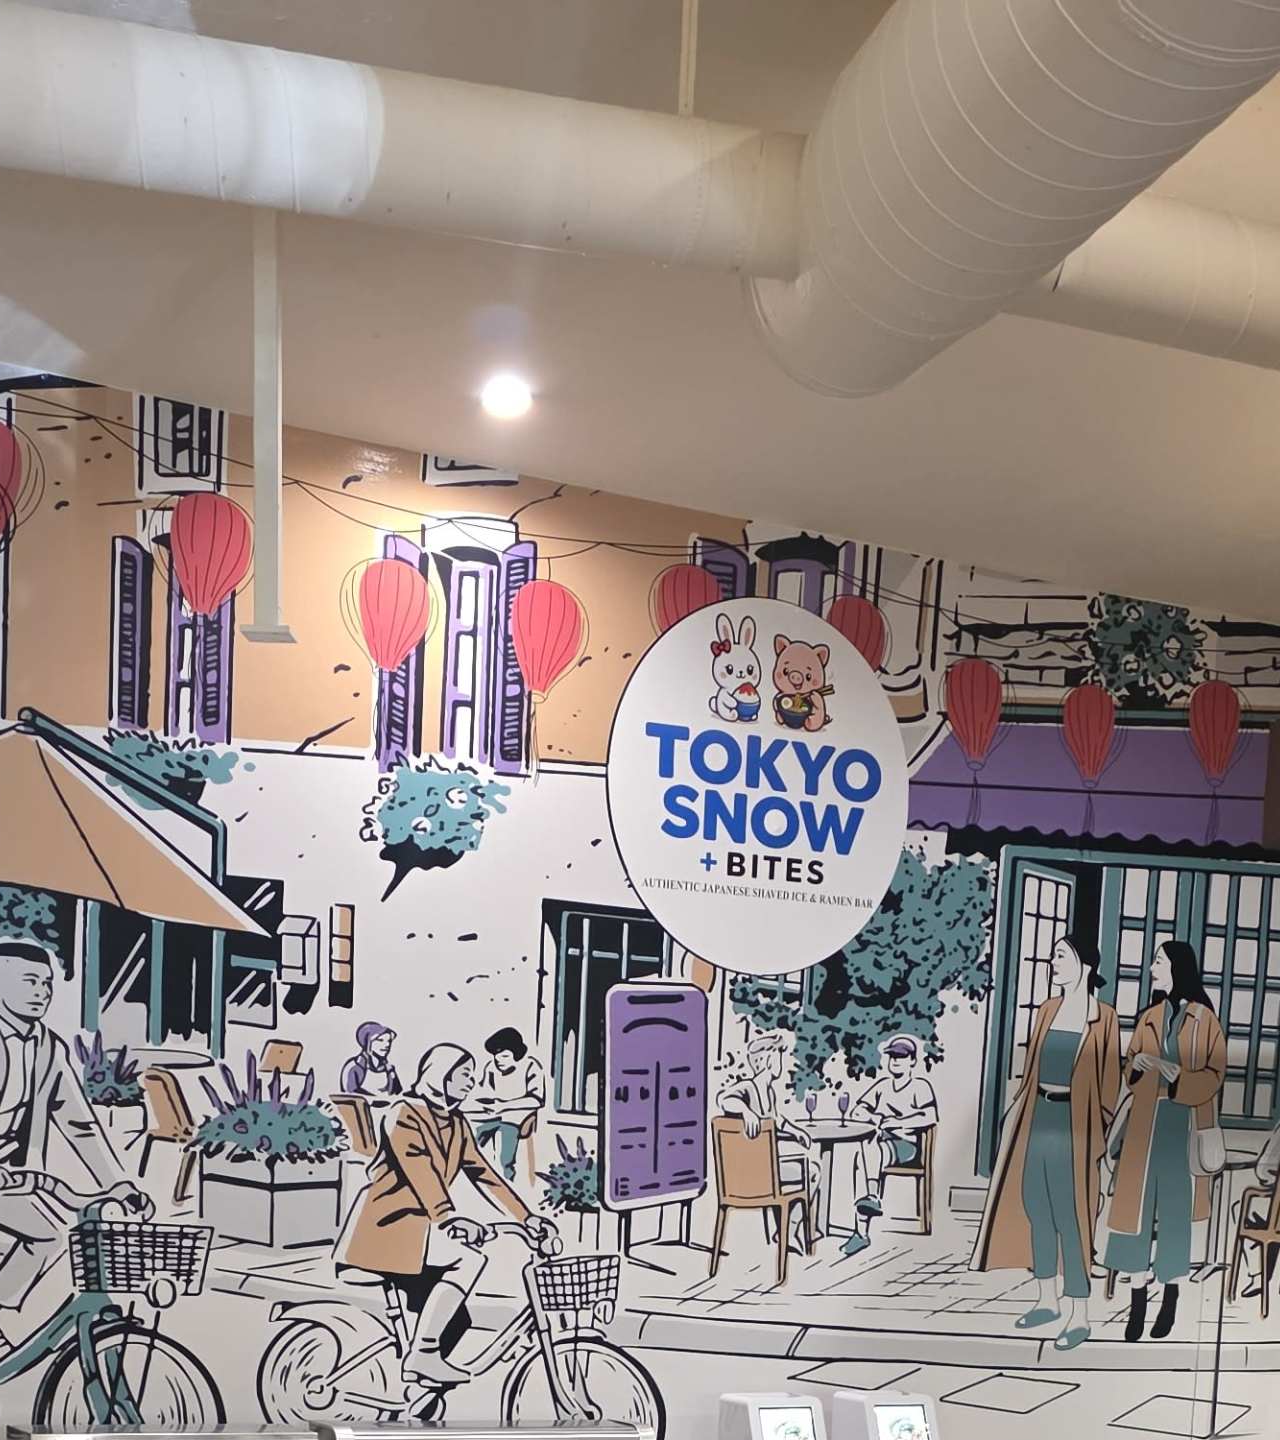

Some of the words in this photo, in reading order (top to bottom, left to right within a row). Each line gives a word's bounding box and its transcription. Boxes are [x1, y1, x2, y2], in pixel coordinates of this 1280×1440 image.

[645, 722, 882, 803] TOKYO
[661, 784, 864, 855] SNOW
[641, 877, 701, 893] AUTHENTIC
[702, 883, 751, 897] JAPANESE
[752, 887, 790, 900] SHAVED
[791, 890, 808, 902] ICE
[809, 893, 817, 904] &
[819, 894, 852, 906] RAMEN
[854, 897, 873, 908] BAR
[727, 852, 824, 884] BITES
